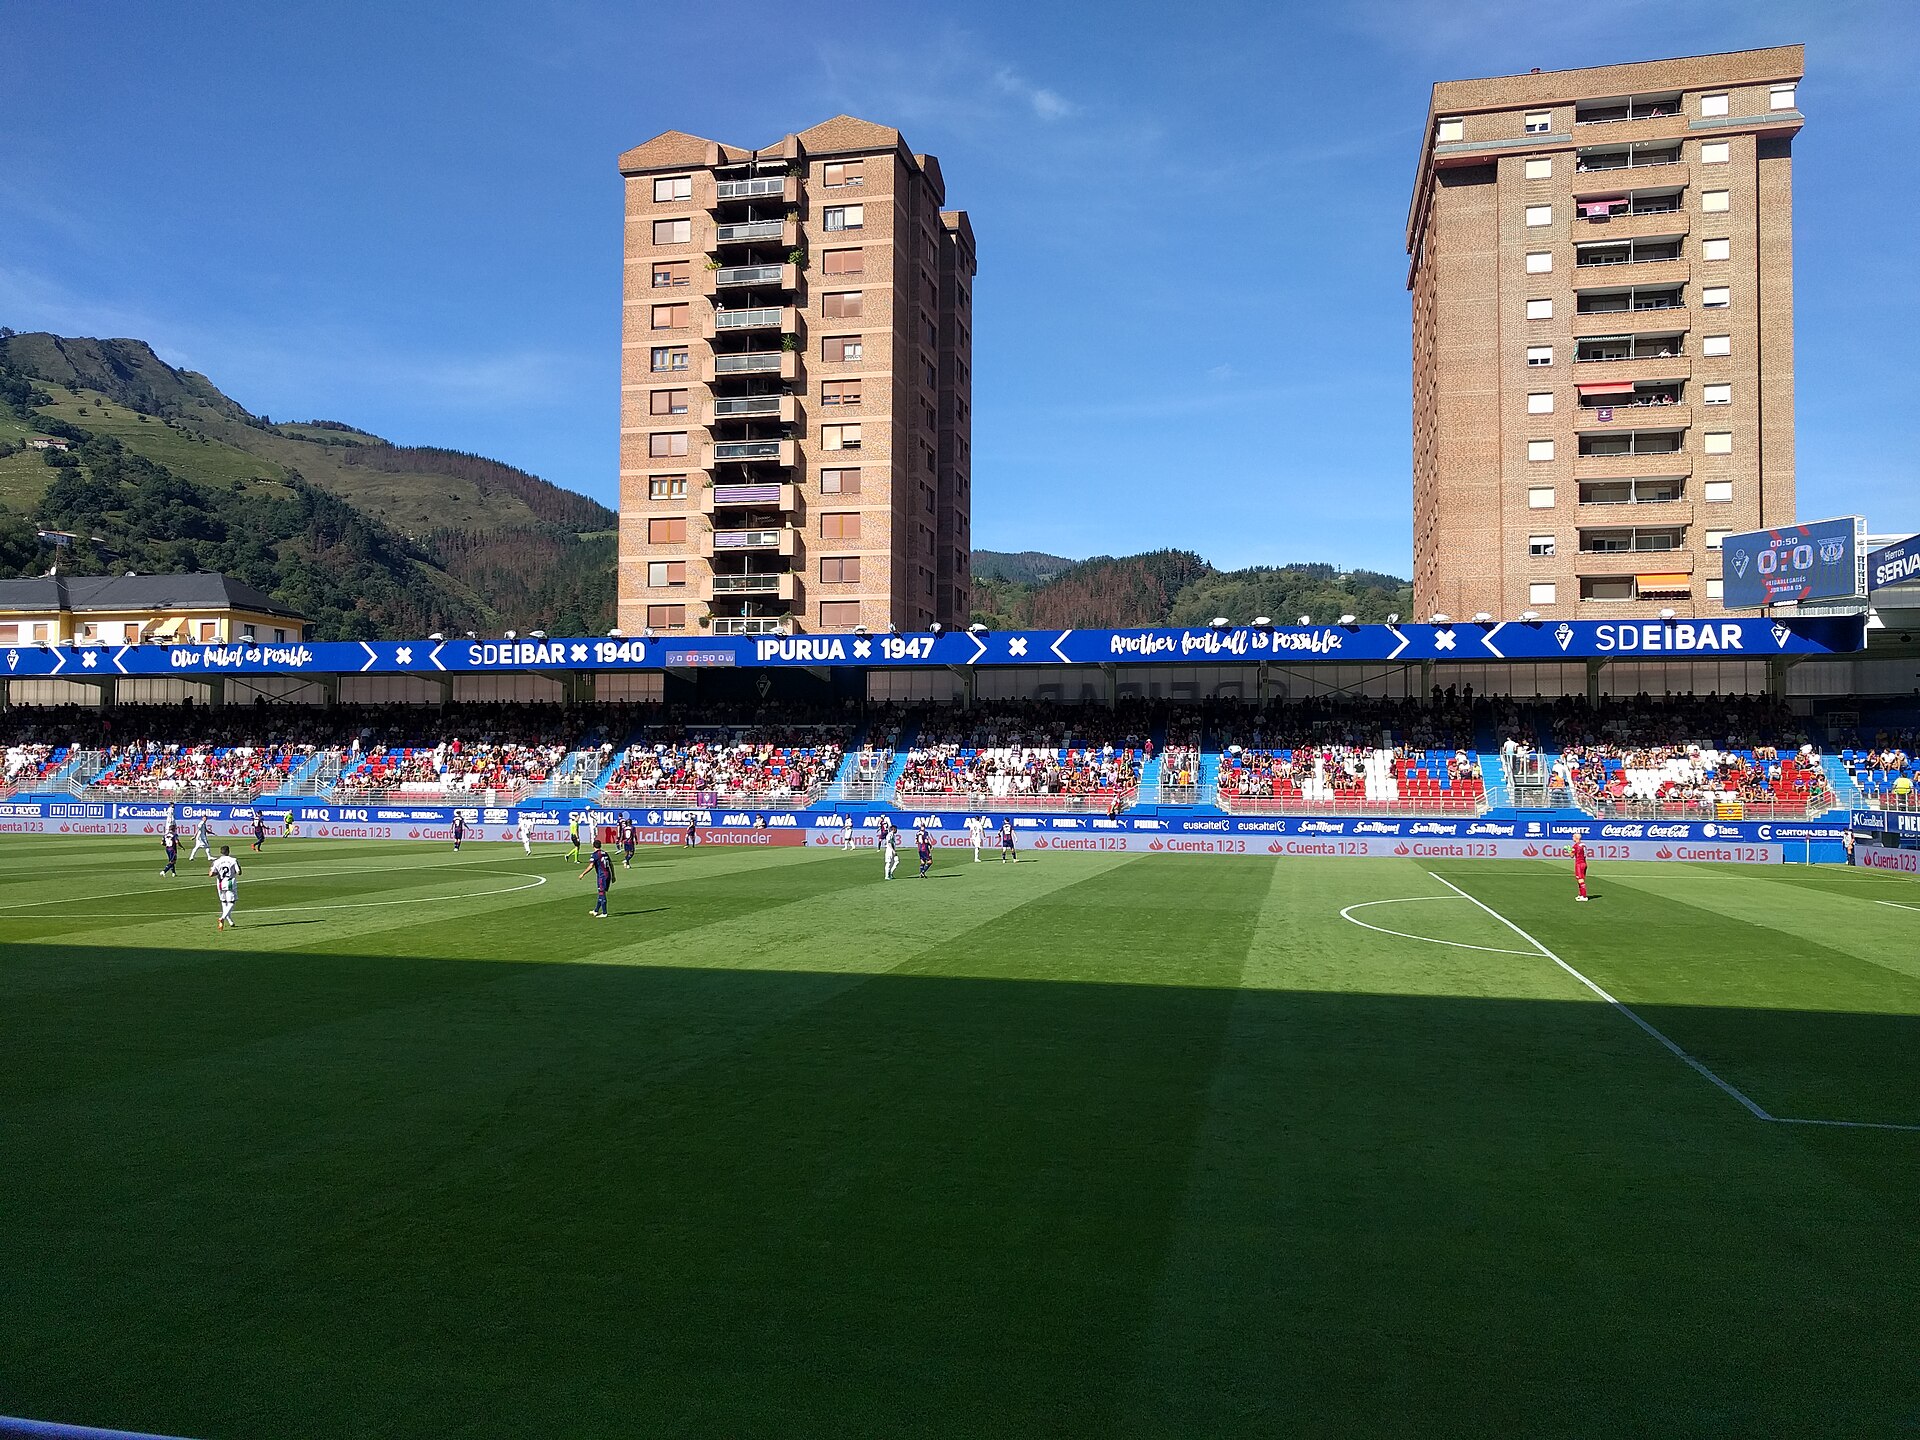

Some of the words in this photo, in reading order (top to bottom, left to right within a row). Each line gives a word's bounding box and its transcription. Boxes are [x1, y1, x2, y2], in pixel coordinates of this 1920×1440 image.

[1770, 537, 1798, 548] 00:50
[1884, 548, 1904, 562] Hierros
[756, 639, 846, 661] IPURUA
[880, 637, 936, 659] 1947
[1181, 631, 1248, 655] football
[1252, 631, 1268, 649] is
[593, 641, 646, 663] 1940
[302, 808, 330, 821] IMQ
[340, 810, 368, 822] IMQ
[72, 822, 106, 833] Cuenta
[1183, 820, 1222, 830] euskaltel
[1238, 821, 1278, 831] euskaltel
[1716, 826, 1738, 835] Taes
[332, 826, 367, 838] Cuenta
[639, 830, 680, 844] LaLiga
[706, 831, 772, 844] Santander
[1052, 836, 1096, 850] Cuenta
[1166, 839, 1214, 852] Cuenta
[1286, 842, 1336, 854] Cuenta
[1413, 843, 1463, 856] Cuenta
[1676, 846, 1731, 860] Cuenta
[1872, 851, 1898, 870] Cuenta
